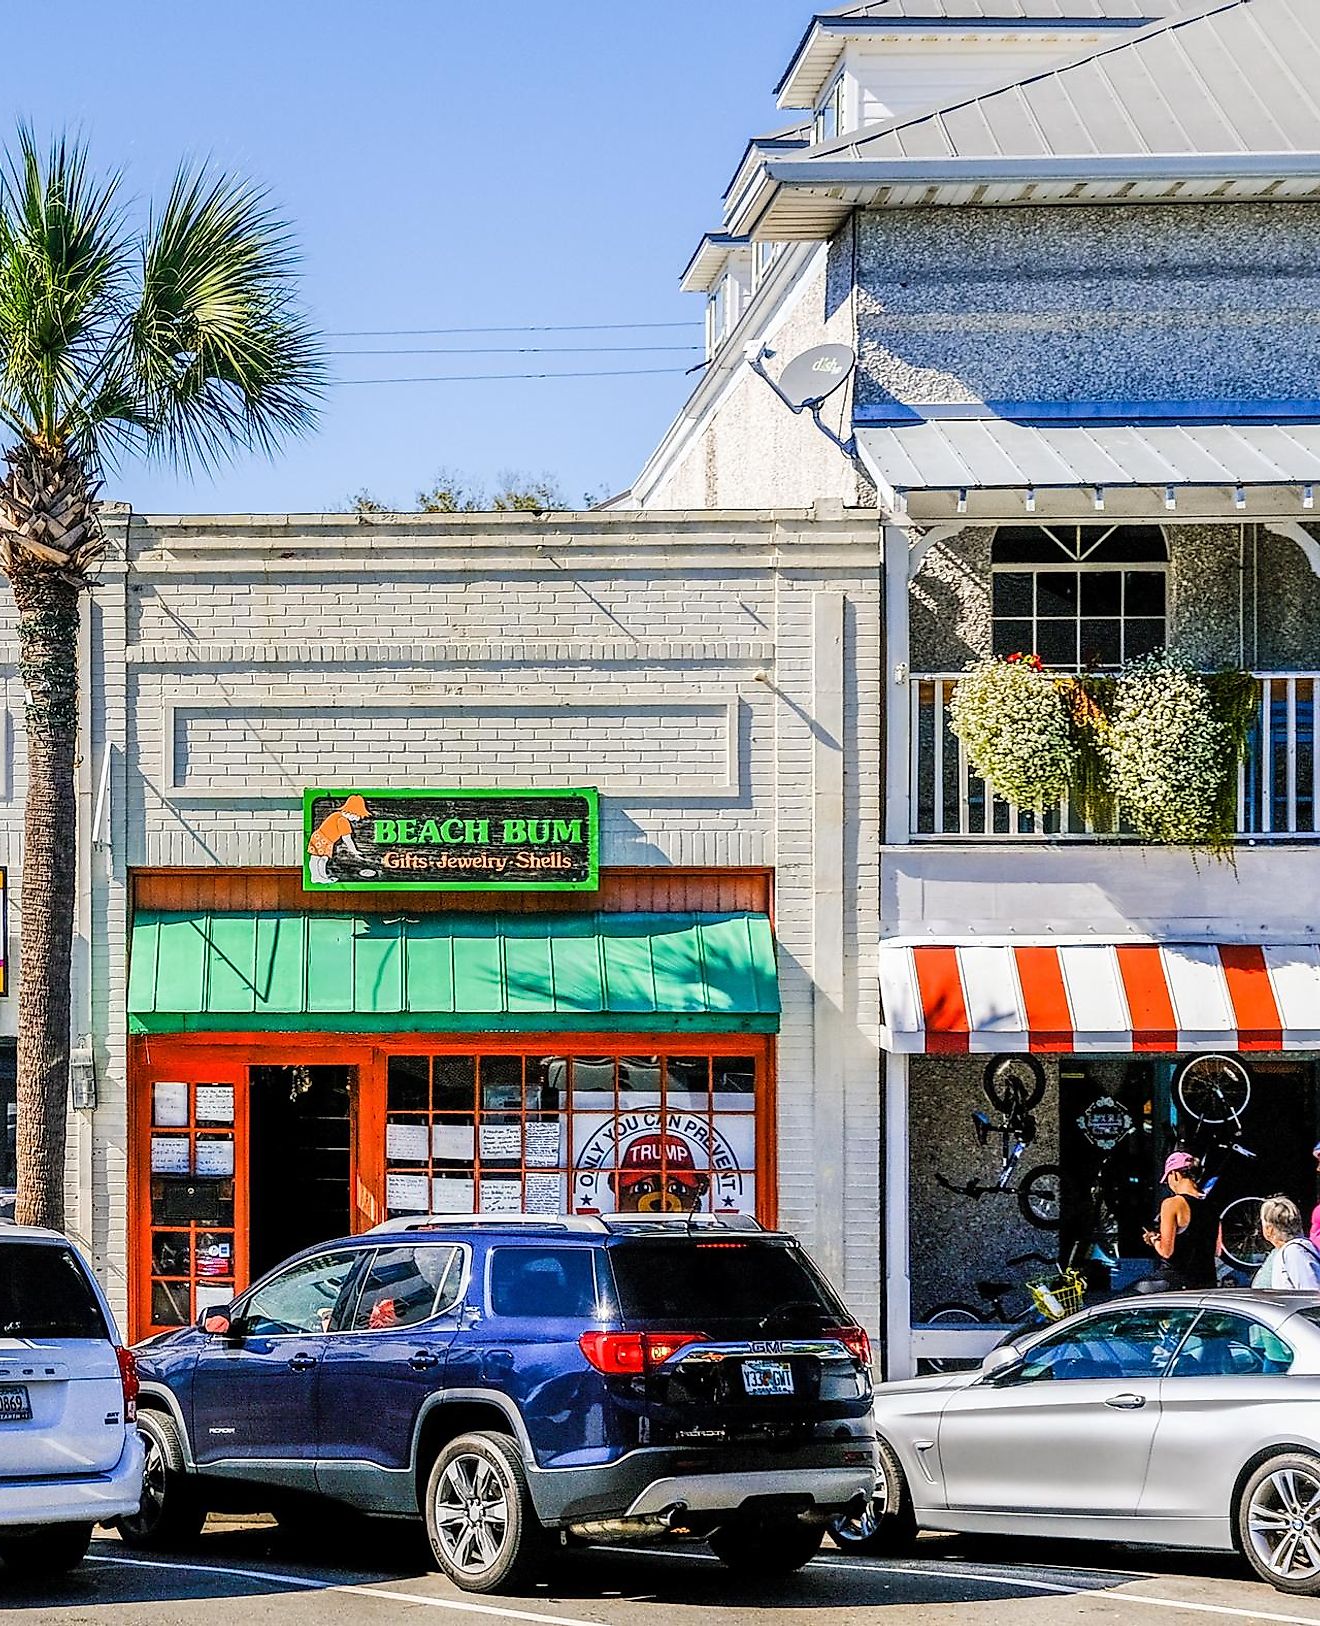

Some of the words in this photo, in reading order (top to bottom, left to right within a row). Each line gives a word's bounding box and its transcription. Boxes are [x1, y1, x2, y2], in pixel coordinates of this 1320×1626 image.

[372, 818, 490, 845] BEACH
[503, 818, 583, 845] BUM
[580, 1141, 605, 1187] ONLY
[602, 1115, 639, 1142] YOU
[683, 1119, 737, 1191] PREVENT
[630, 1143, 689, 1162] TRUMP
[750, 1341, 793, 1354] GMC
